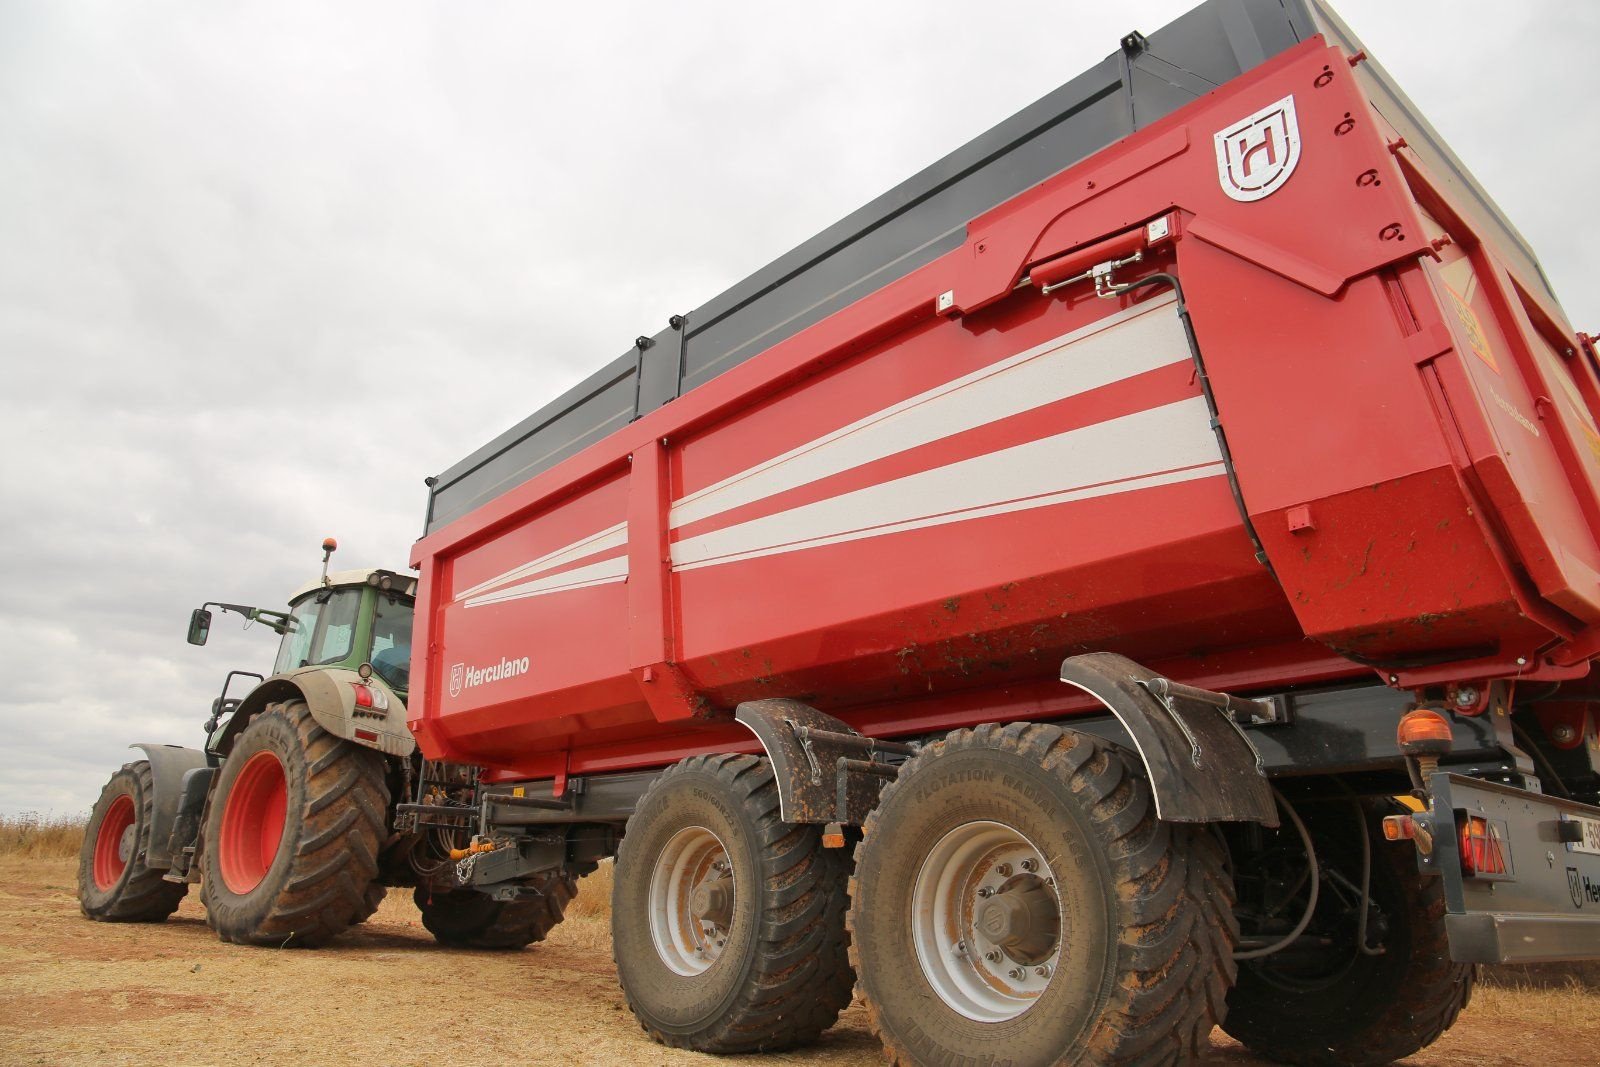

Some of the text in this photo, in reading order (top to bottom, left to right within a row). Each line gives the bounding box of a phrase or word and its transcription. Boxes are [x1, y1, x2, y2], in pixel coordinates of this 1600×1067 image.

[465, 656, 530, 688] Herculano
[916, 769, 994, 803] FLOTATION
[1003, 774, 1056, 820] RADIAL
